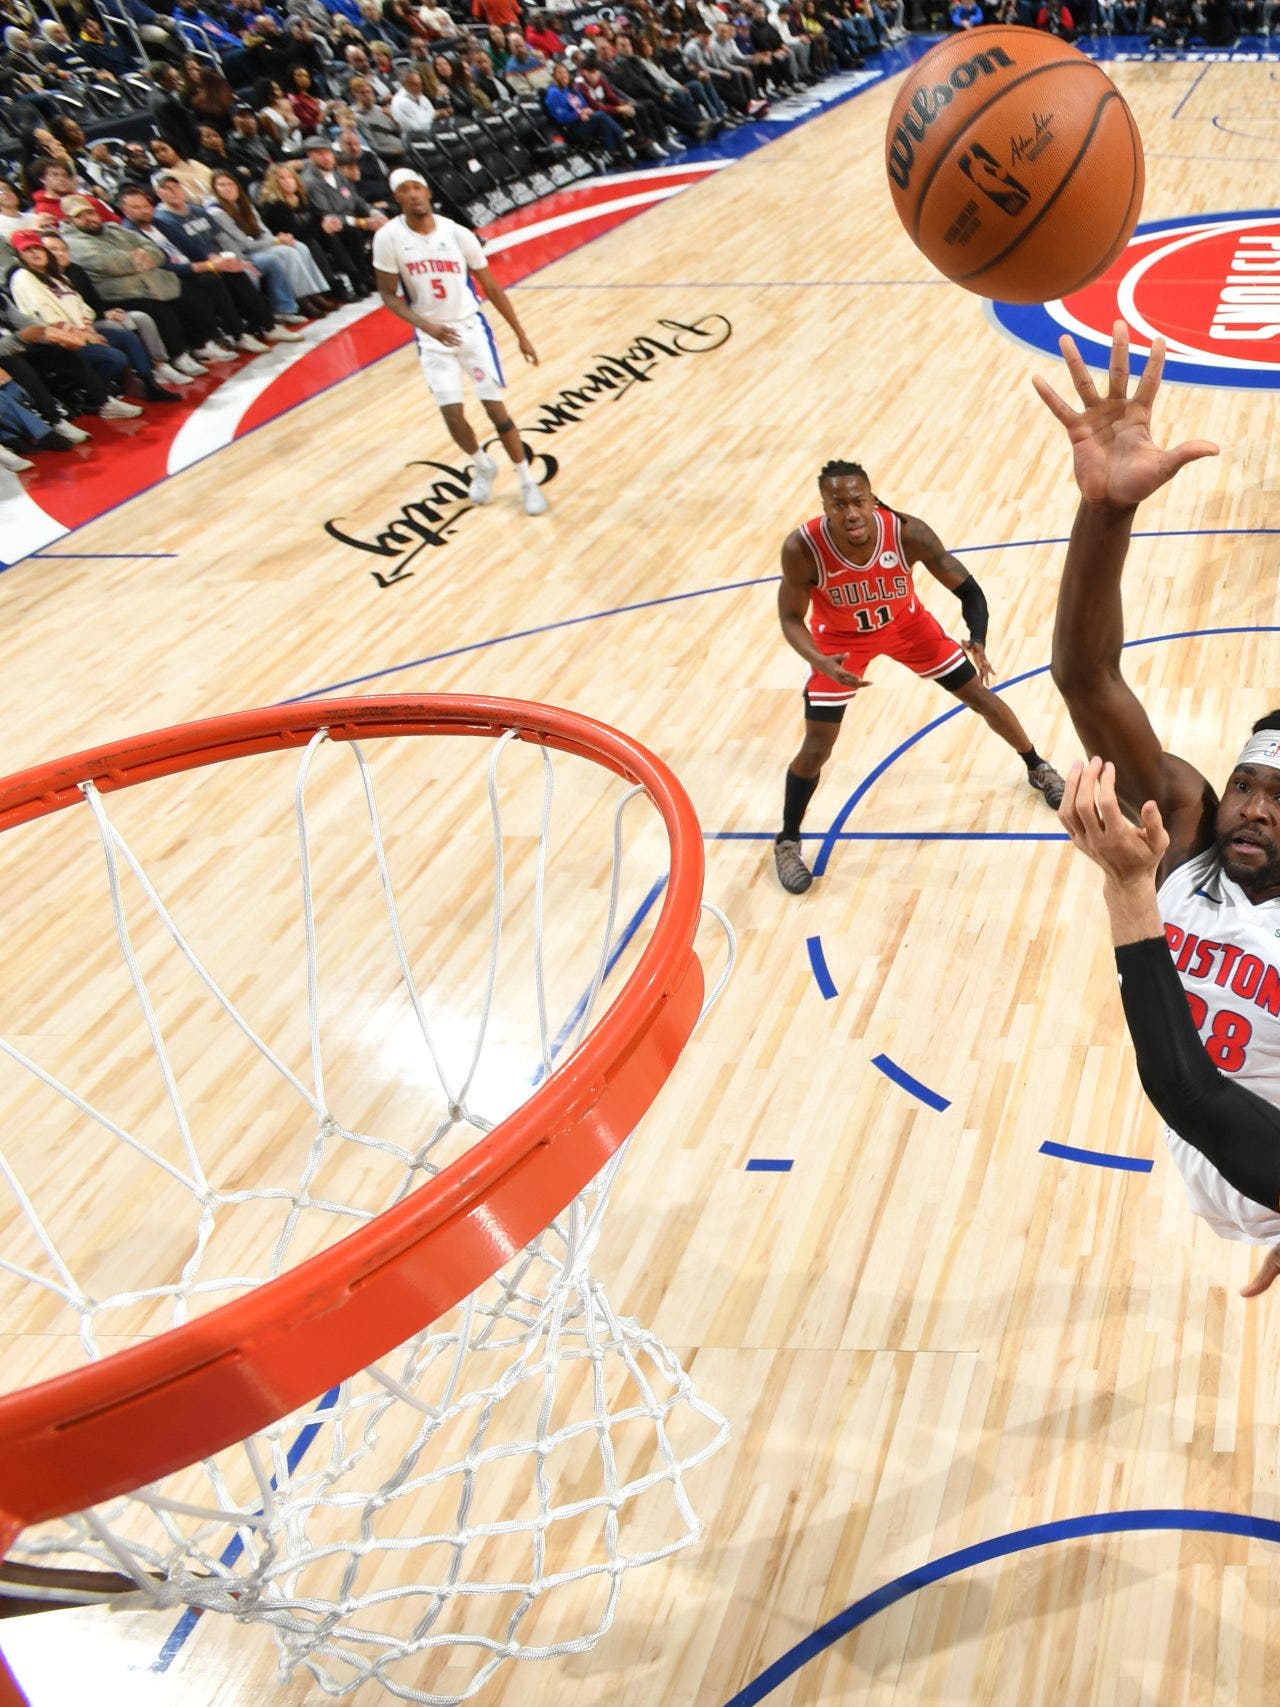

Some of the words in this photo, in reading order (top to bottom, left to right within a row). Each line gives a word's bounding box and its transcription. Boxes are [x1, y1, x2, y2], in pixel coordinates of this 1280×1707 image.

[888, 46, 1016, 191] Wilson
[406, 259, 462, 276] PISTONS
[430, 279, 447, 299] 5
[828, 576, 908, 607] BULLS
[854, 604, 893, 633] 11
